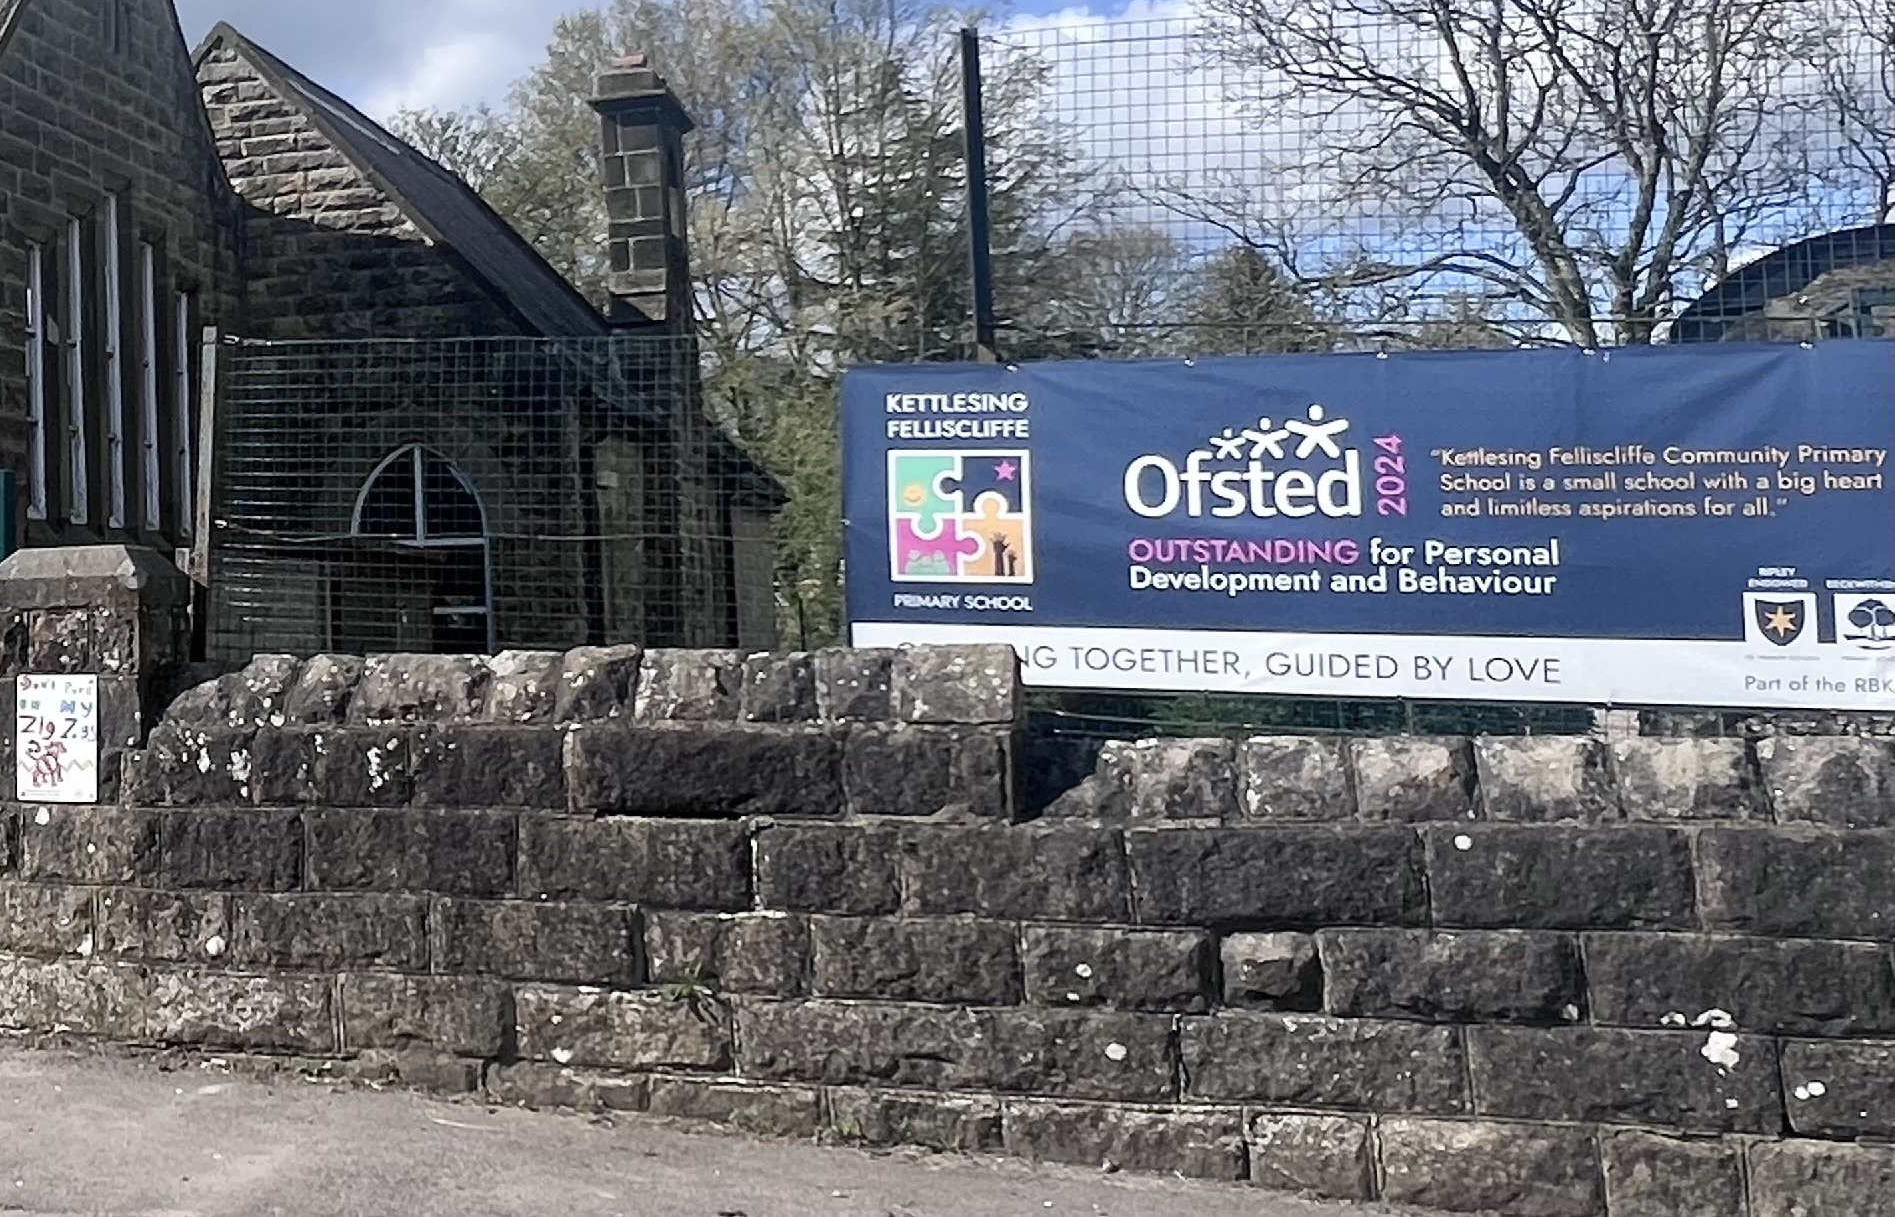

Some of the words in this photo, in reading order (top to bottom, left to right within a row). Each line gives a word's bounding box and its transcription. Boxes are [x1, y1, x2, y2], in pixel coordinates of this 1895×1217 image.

[885, 393, 1028, 413] KETTLESING
[886, 419, 1030, 439] FELLISCLIFFE
[1549, 444, 1656, 466] Felliscliffe
[1663, 446, 1791, 469] Community
[1797, 444, 1888, 467] Primary
[1123, 449, 1363, 518] Ofsted
[1372, 434, 1408, 517] 2024
[1440, 472, 1511, 492] School
[1518, 473, 1536, 491] is
[1542, 477, 1556, 491] a
[1563, 471, 1617, 492] small
[1624, 470, 1696, 492] school
[1704, 471, 1749, 490] with
[1756, 476, 1770, 490] a
[1777, 470, 1816, 495] big
[1824, 469, 1884, 490] heart
[1441, 497, 1480, 517] and
[1488, 497, 1572, 517] limitless
[1578, 498, 1698, 521] aspirations
[1704, 496, 1736, 516] for
[1127, 538, 1360, 564] OUTSTANDING
[1369, 537, 1415, 565] for
[1425, 538, 1560, 566] Personal
[1129, 564, 1322, 597] Development
[1330, 567, 1388, 593] and
[1398, 566, 1558, 594] Behaviour
[894, 593, 961, 610] PRIMARY
[964, 595, 1033, 612] SCHOOL
[1069, 645, 1251, 679] TOGETHER,
[1265, 652, 1398, 679] GUIDED
[1414, 655, 1453, 681] BY
[1468, 656, 1562, 683] LOVE
[1744, 675, 1781, 691] Part
[1788, 675, 1808, 692] of
[1816, 676, 1846, 693] the
